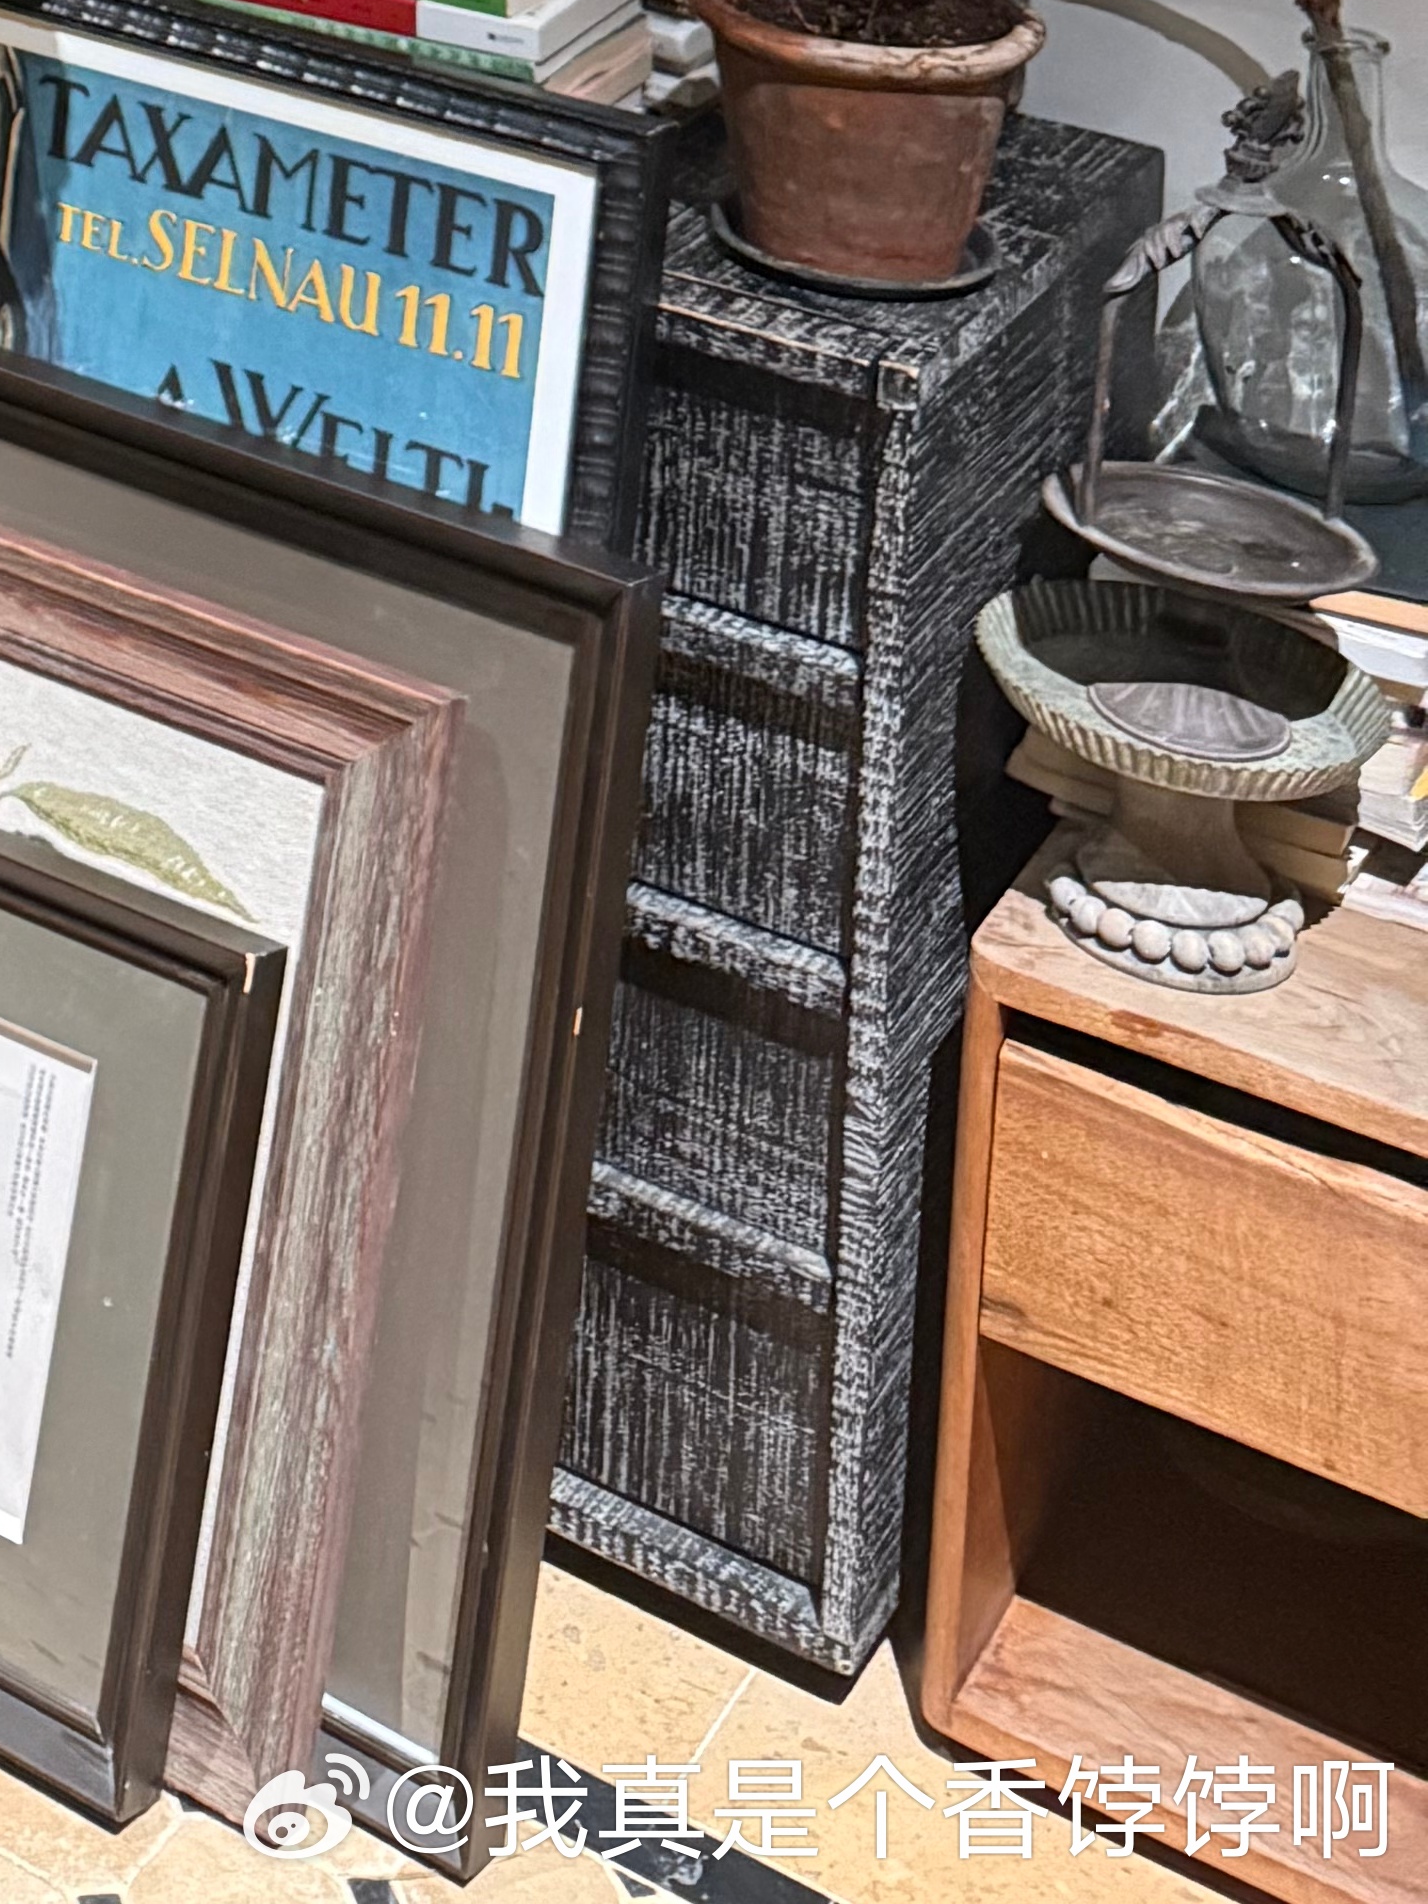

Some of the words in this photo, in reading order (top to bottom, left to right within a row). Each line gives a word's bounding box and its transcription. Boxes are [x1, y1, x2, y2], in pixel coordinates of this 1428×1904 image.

[38, 74, 546, 298] TAXAMETER
[56, 202, 141, 266] TEL.
[141, 208, 381, 338] SELNAU
[394, 284, 525, 379] 11.11
